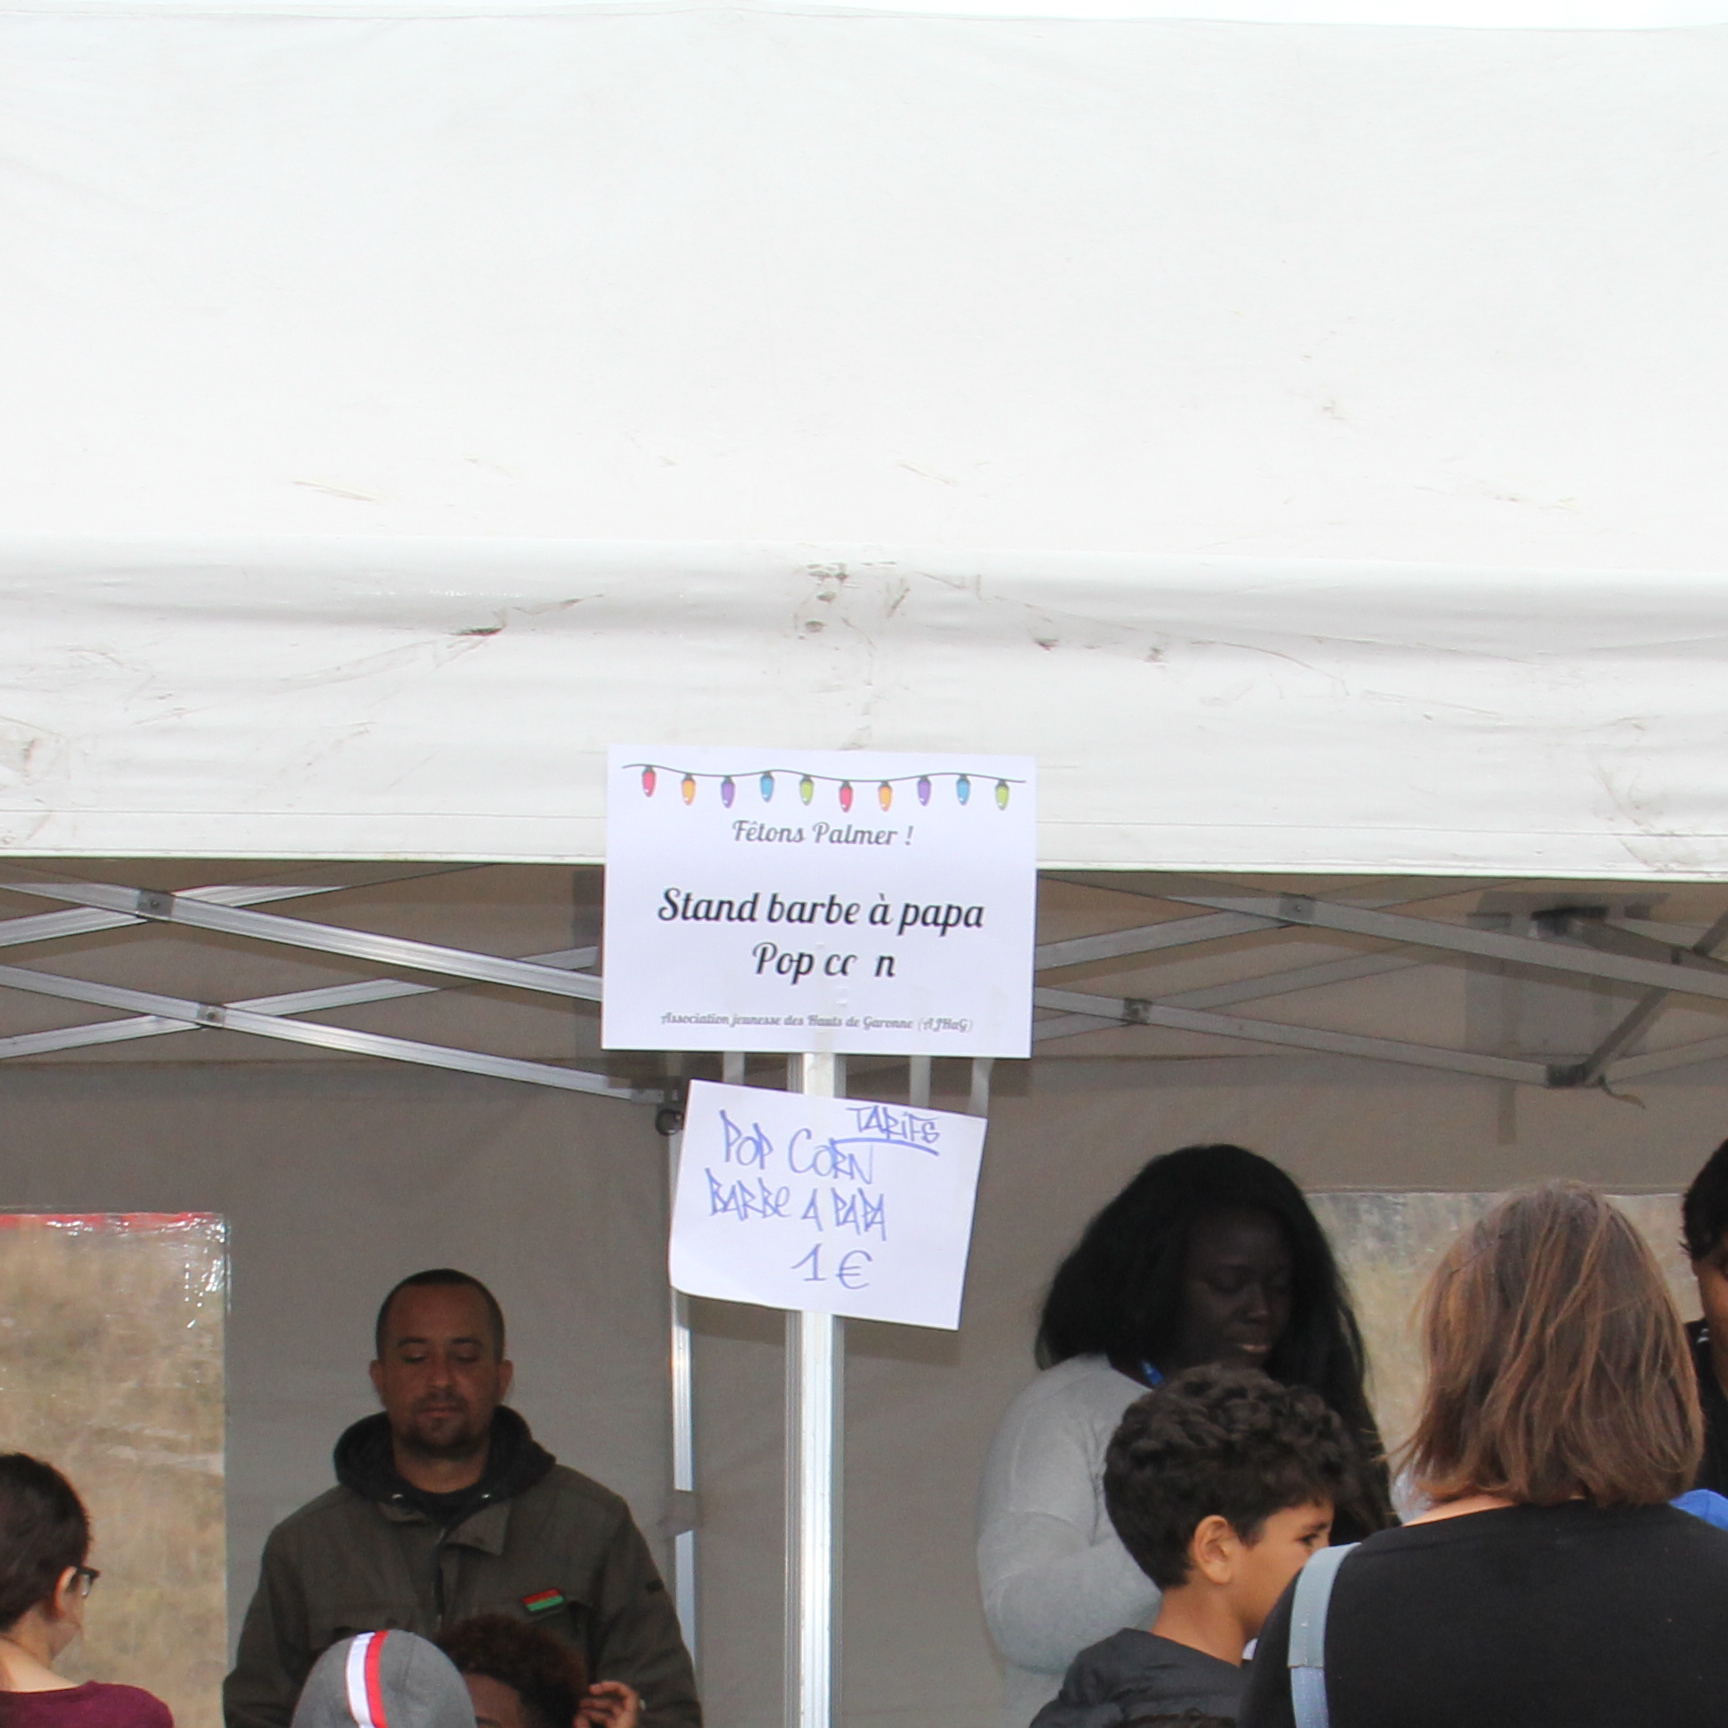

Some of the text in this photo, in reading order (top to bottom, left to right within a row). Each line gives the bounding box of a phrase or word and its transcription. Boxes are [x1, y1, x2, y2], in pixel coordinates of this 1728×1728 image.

[732, 820, 806, 843] Fêtons
[812, 821, 898, 845] Palmer
[658, 887, 985, 938] Stand barbe à papa
[752, 941, 814, 985] Pop
[661, 1012, 729, 1026] Association
[729, 1013, 782, 1028] jeunesse
[783, 1014, 804, 1026] des
[845, 1015, 860, 1028] de
[863, 1015, 914, 1031] Garonne
[719, 1109, 774, 1170] POP
[831, 1187, 887, 1242] PAPA
